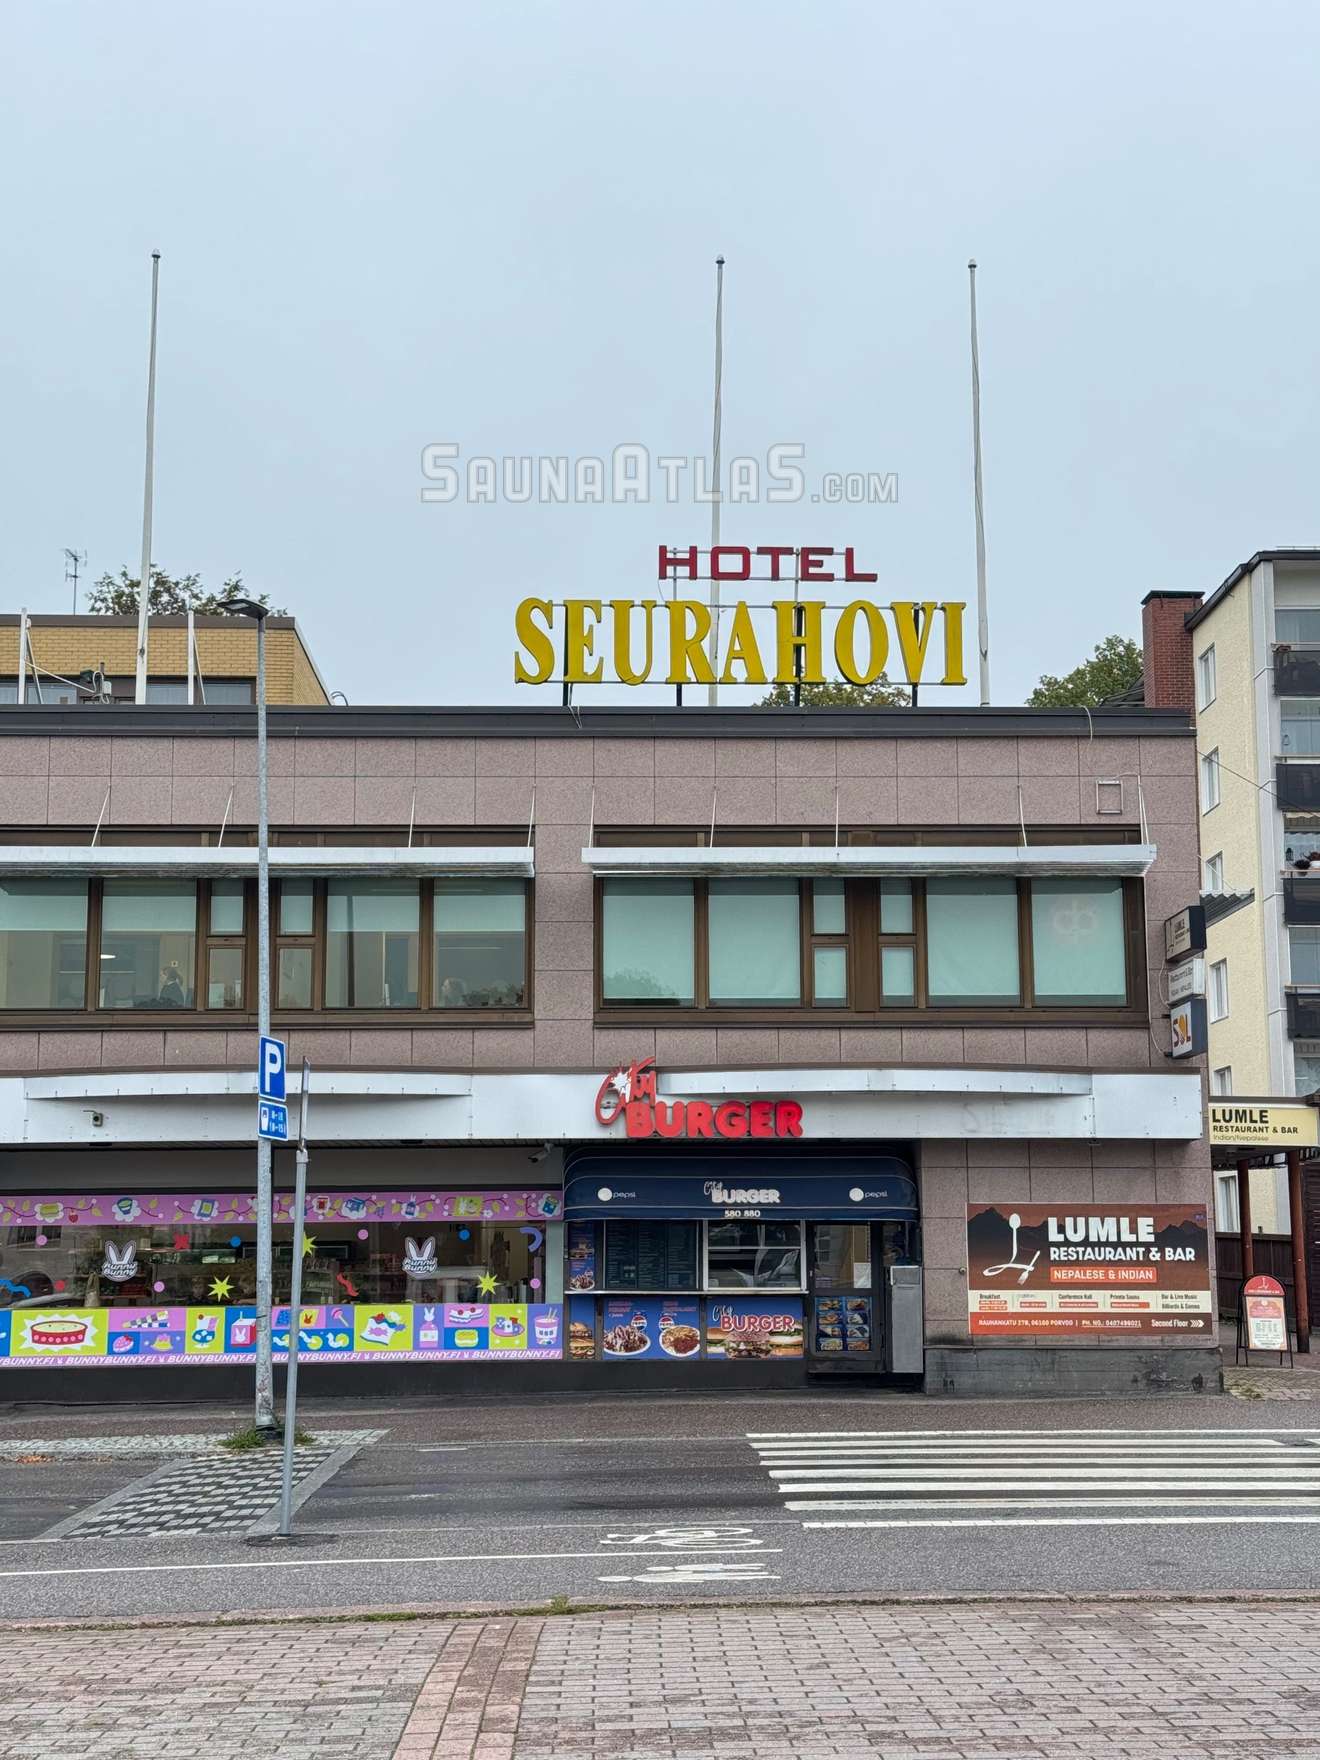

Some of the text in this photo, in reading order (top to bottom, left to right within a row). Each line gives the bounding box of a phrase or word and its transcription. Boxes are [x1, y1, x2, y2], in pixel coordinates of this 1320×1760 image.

[658, 544, 877, 582] HOTEL
[515, 597, 967, 686] SEURAHOVI
[1173, 1014, 1191, 1047] SOL
[265, 1042, 281, 1092] P
[626, 1100, 803, 1138] BURGER
[1212, 1109, 1268, 1124] LUMLE
[1213, 1125, 1269, 1133] RESTAURANT
[613, 1191, 636, 1199] pepsi
[711, 1189, 780, 1203] BURGER
[865, 1190, 888, 1199] pepsi
[1047, 1216, 1155, 1242] LUMLE
[1050, 1246, 1195, 1261] RESTAURANT & BAR
[1054, 1270, 1153, 1280] NEPALESE & INDIAN
[720, 1314, 796, 1333] BURGER
[1151, 1319, 1188, 1328] Second Floor
